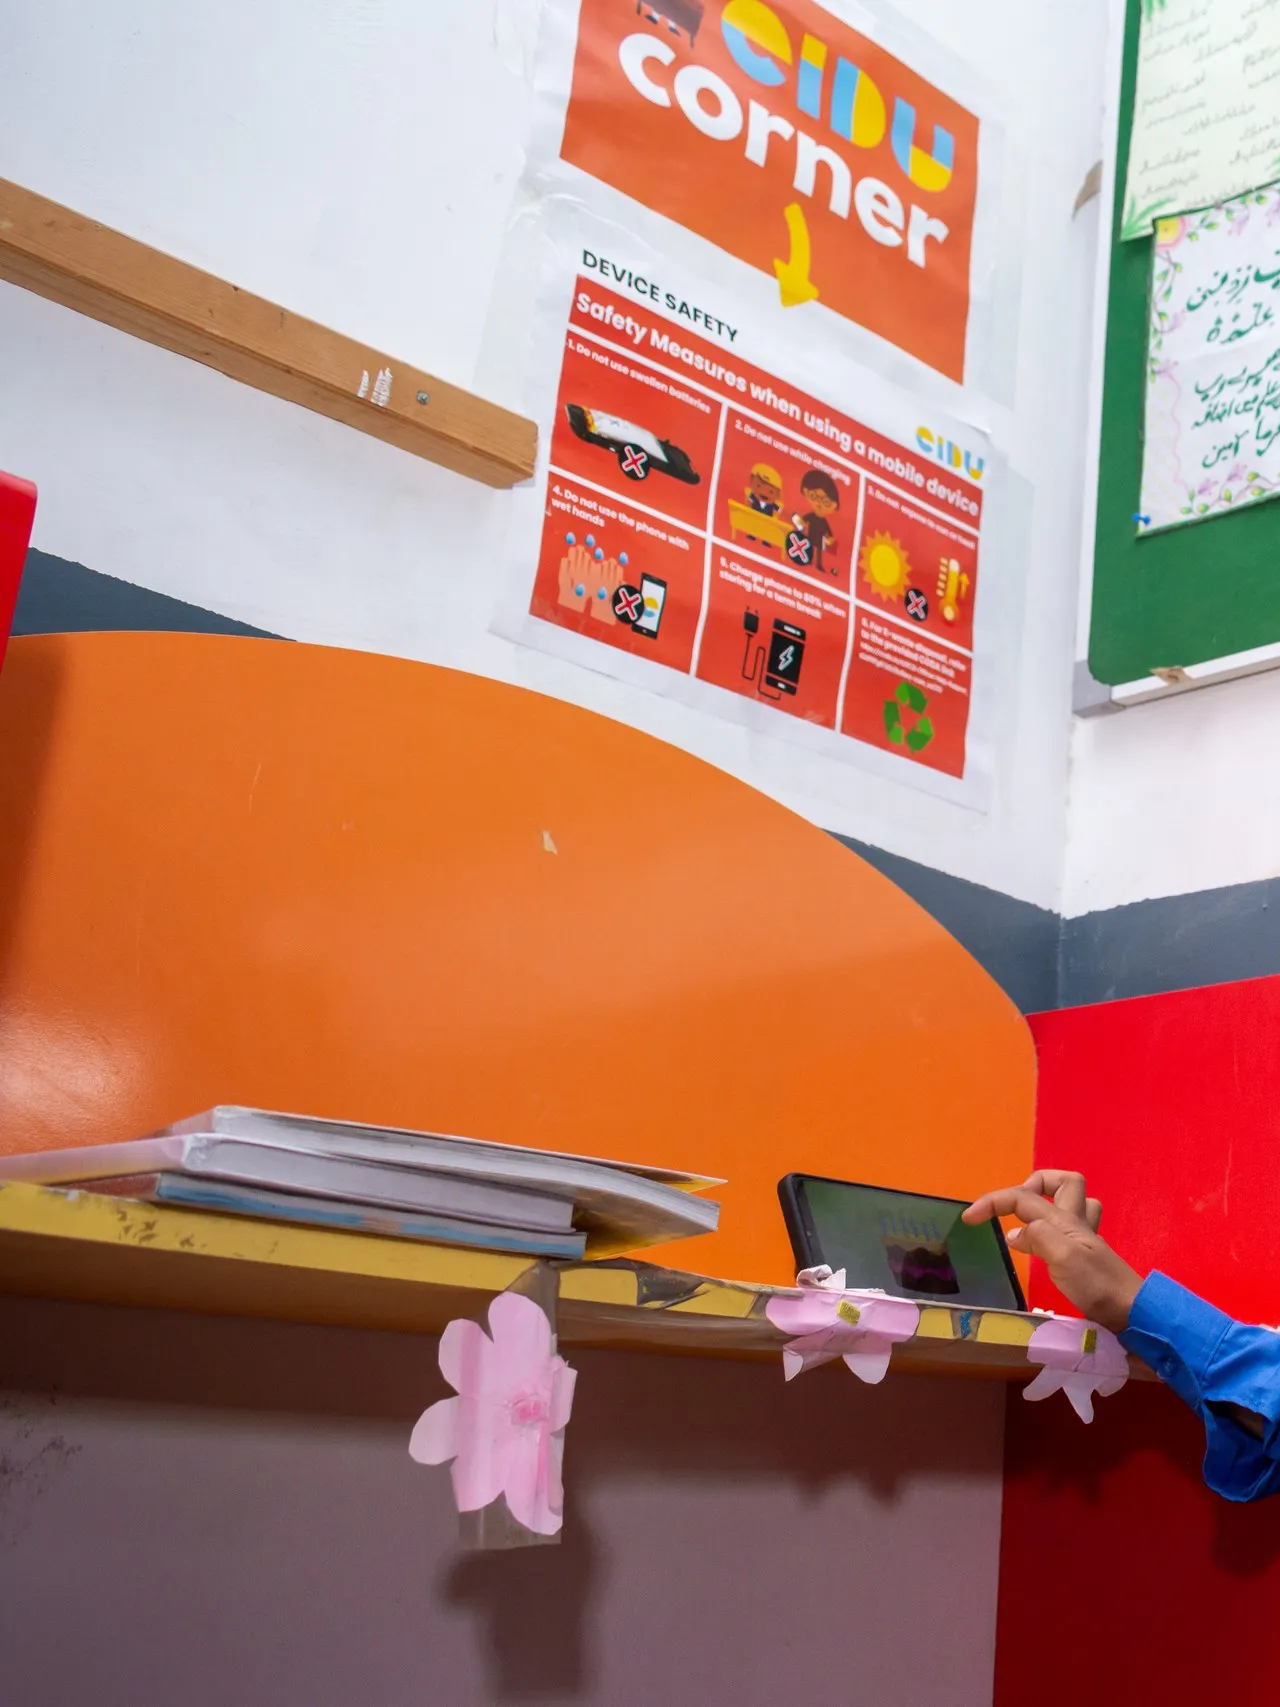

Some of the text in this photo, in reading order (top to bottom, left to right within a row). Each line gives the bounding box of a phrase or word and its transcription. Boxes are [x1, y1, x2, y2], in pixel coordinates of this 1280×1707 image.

[618, 33, 949, 268] corner
[583, 249, 738, 342] DEVICE SAFETY
[576, 293, 979, 516] Safety Measures when using a mobile device
[577, 342, 591, 357] Do
[592, 351, 609, 366] not
[610, 360, 629, 375] use
[630, 369, 668, 393] swollen
[669, 385, 711, 414] batteries
[744, 424, 757, 437] Do
[757, 432, 772, 445] not
[789, 447, 812, 465] while
[813, 459, 851, 486] charging
[552, 498, 605, 527] wet hands
[553, 485, 690, 551] 4. Do not use the phone with
[719, 570, 822, 620] storing for a term break
[729, 562, 763, 583] Charge
[764, 577, 792, 595] phone
[793, 588, 803, 599] to
[823, 601, 846, 618] when
